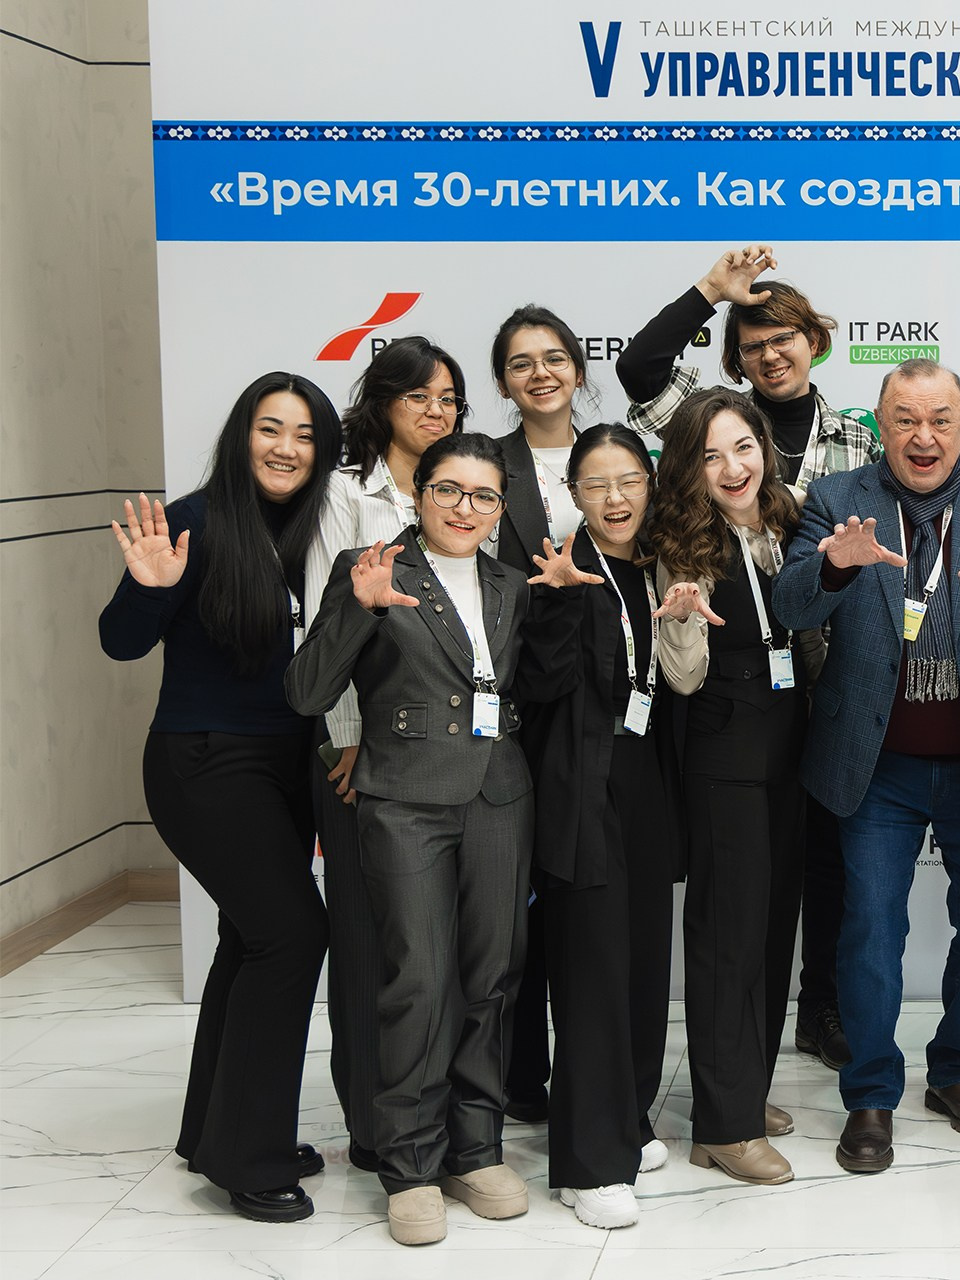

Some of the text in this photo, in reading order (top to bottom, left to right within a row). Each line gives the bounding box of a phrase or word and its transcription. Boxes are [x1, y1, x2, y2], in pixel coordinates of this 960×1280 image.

[639, 17, 833, 37] ТАШКЕНТСКИЙ
[582, 20, 619, 97] V
[210, 171, 397, 214] «Время
[414, 171, 680, 206] 30-летних.
[698, 172, 786, 206] Как
[849, 322, 939, 341] IT PARK
[852, 346, 937, 361] UZBEKISTAN
